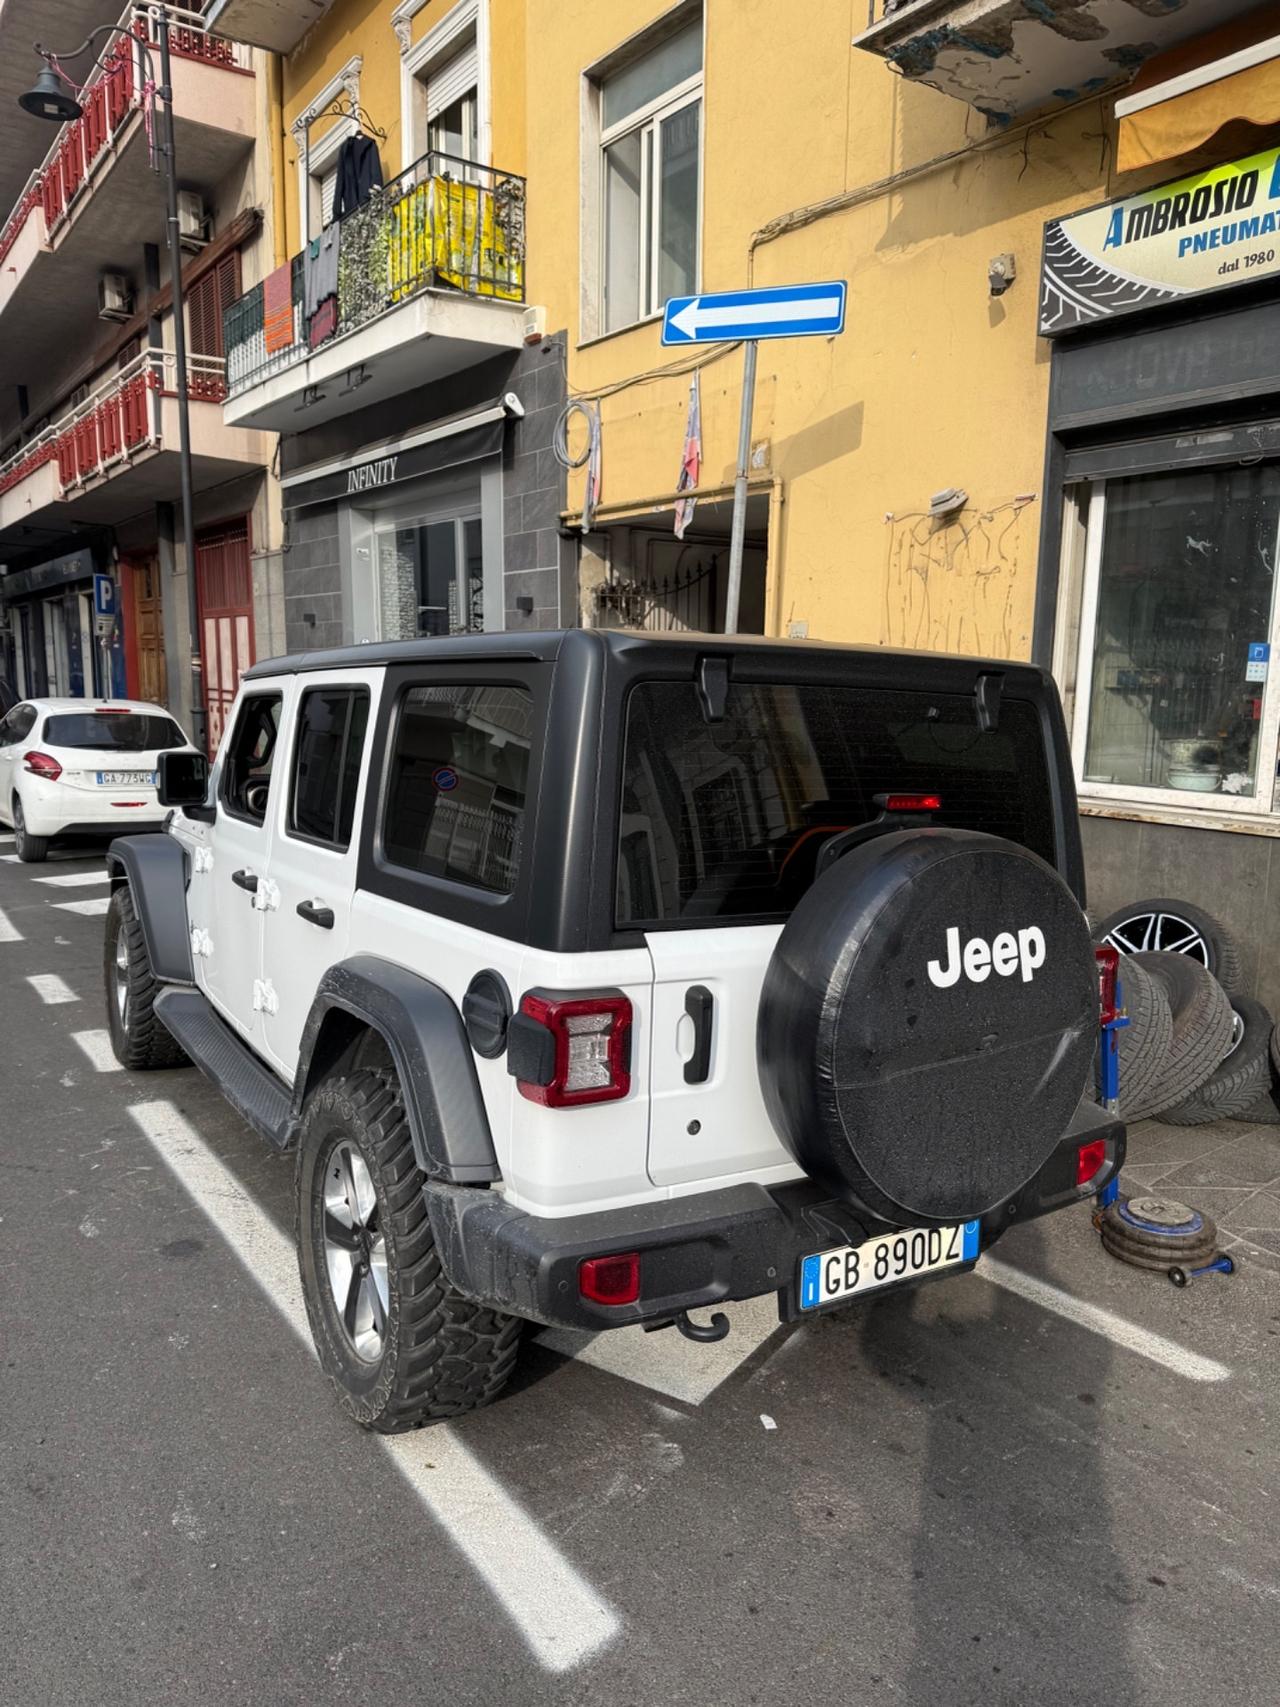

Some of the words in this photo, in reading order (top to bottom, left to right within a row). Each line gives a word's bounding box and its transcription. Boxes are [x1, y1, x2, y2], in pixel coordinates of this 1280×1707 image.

[1218, 258, 1239, 275] dal
[1244, 249, 1275, 268] 1980
[347, 456, 398, 493] INFINITY
[100, 579, 112, 610] P
[927, 925, 1046, 988] Jeep
[825, 1250, 860, 1295] GB
[874, 1223, 961, 1281] 890DZ
